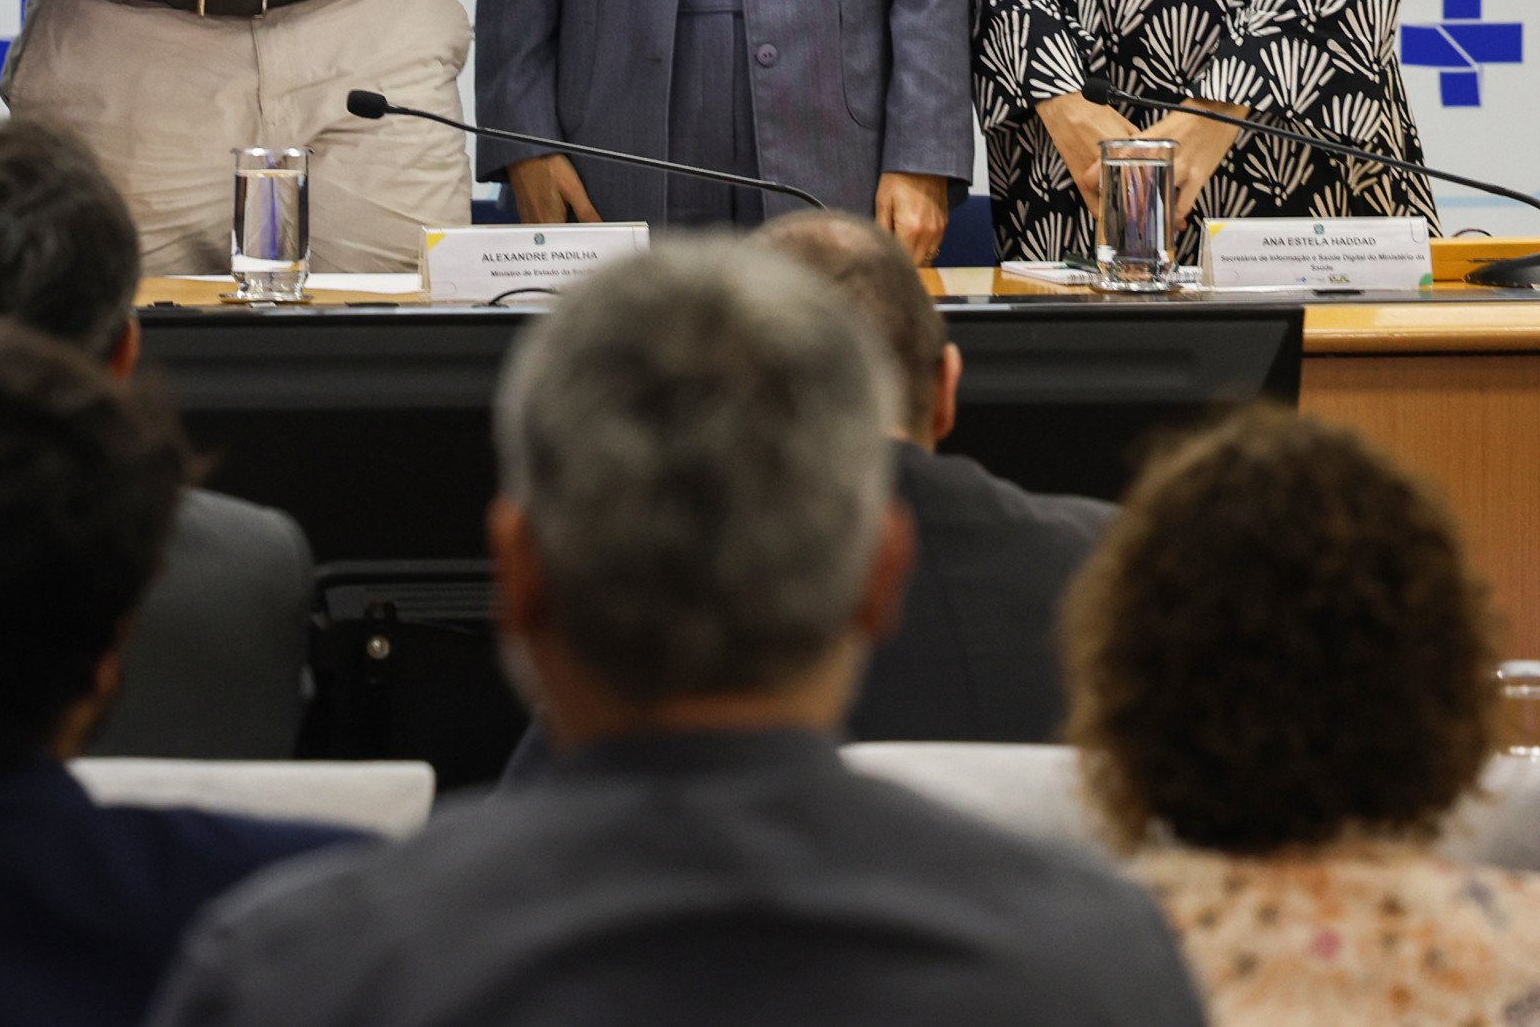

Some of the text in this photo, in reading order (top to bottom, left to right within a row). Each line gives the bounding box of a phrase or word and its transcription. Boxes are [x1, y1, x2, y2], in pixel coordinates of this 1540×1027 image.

[1262, 237, 1377, 247] ANA ESTELA HADDAD
[481, 250, 599, 262] ALEXANDRE PADILHA
